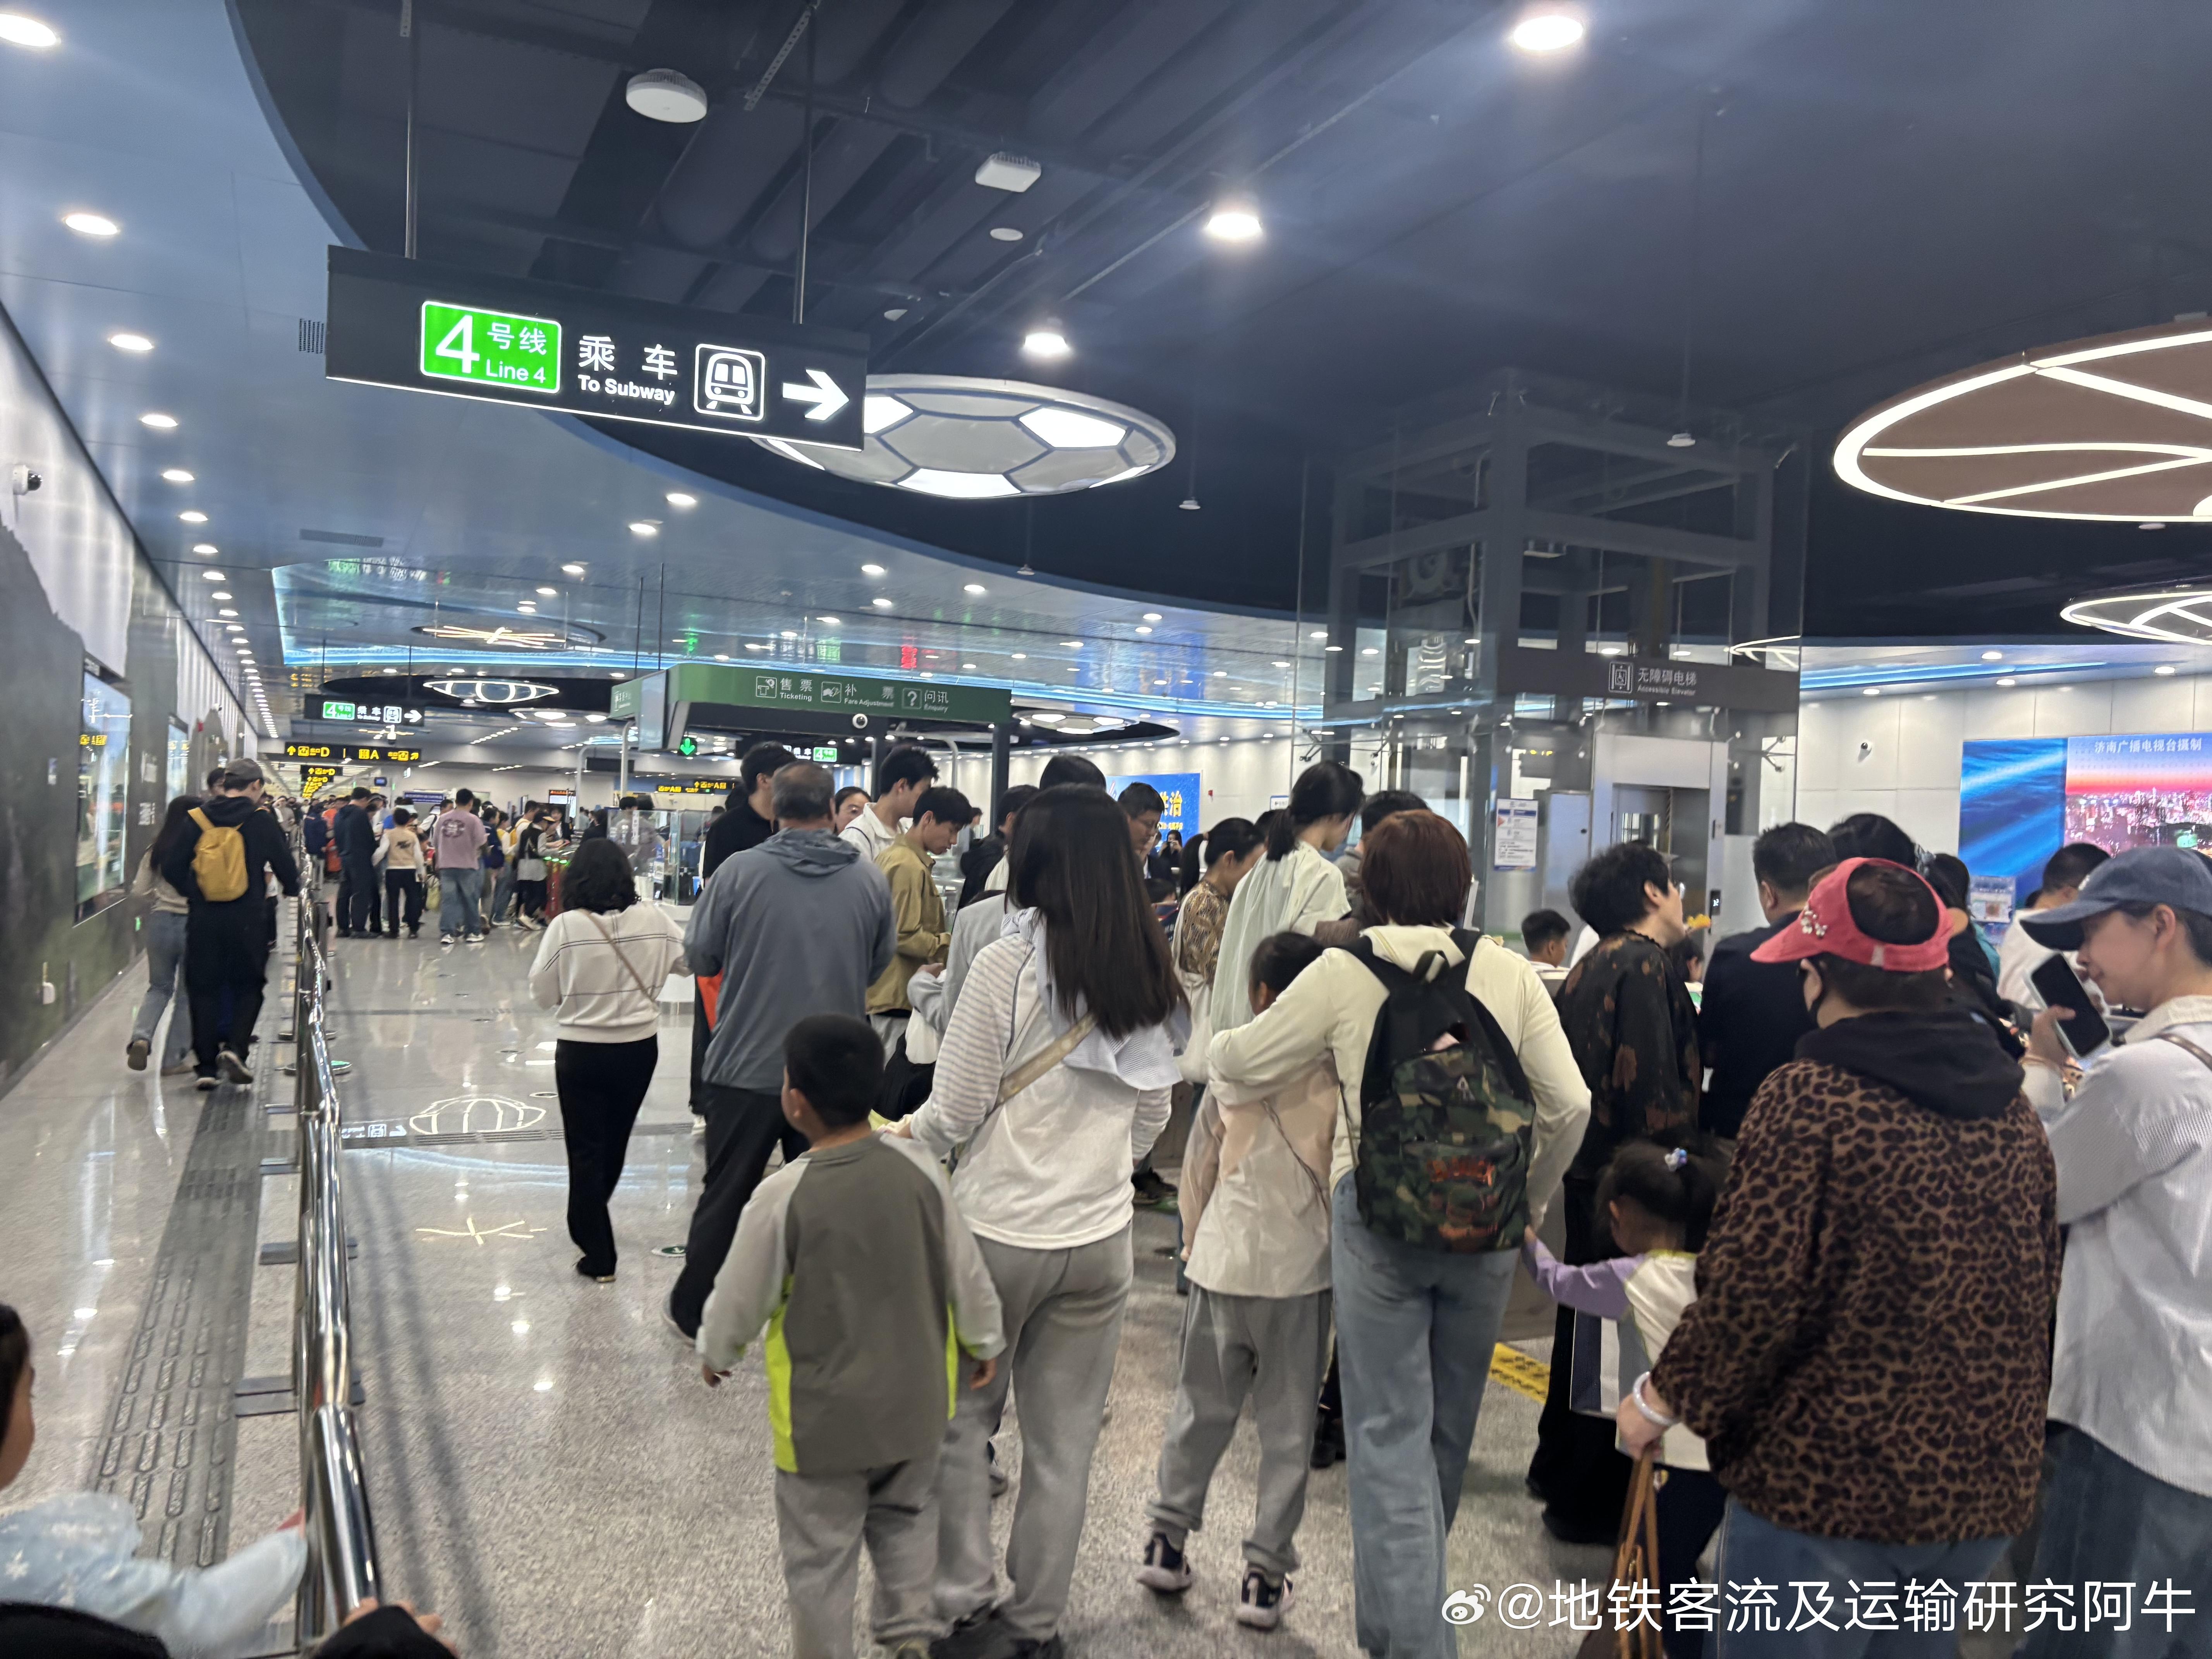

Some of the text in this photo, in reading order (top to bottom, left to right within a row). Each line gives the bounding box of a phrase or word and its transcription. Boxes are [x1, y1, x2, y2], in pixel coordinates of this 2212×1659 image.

[436, 314, 547, 374] 4 号线
[578, 335, 678, 380] 乘车
[486, 359, 546, 383] Line 4
[578, 374, 675, 405] To Subway
[780, 678, 812, 692] 售票
[1638, 668, 1697, 686] 无障碍电梯
[780, 692, 812, 702] Ticketing
[924, 690, 949, 704] 问讯
[326, 703, 337, 718] 4
[321, 747, 330, 757] D
[2094, 737, 2202, 754] 济南广播电视台摄制
[370, 749, 380, 759] A
